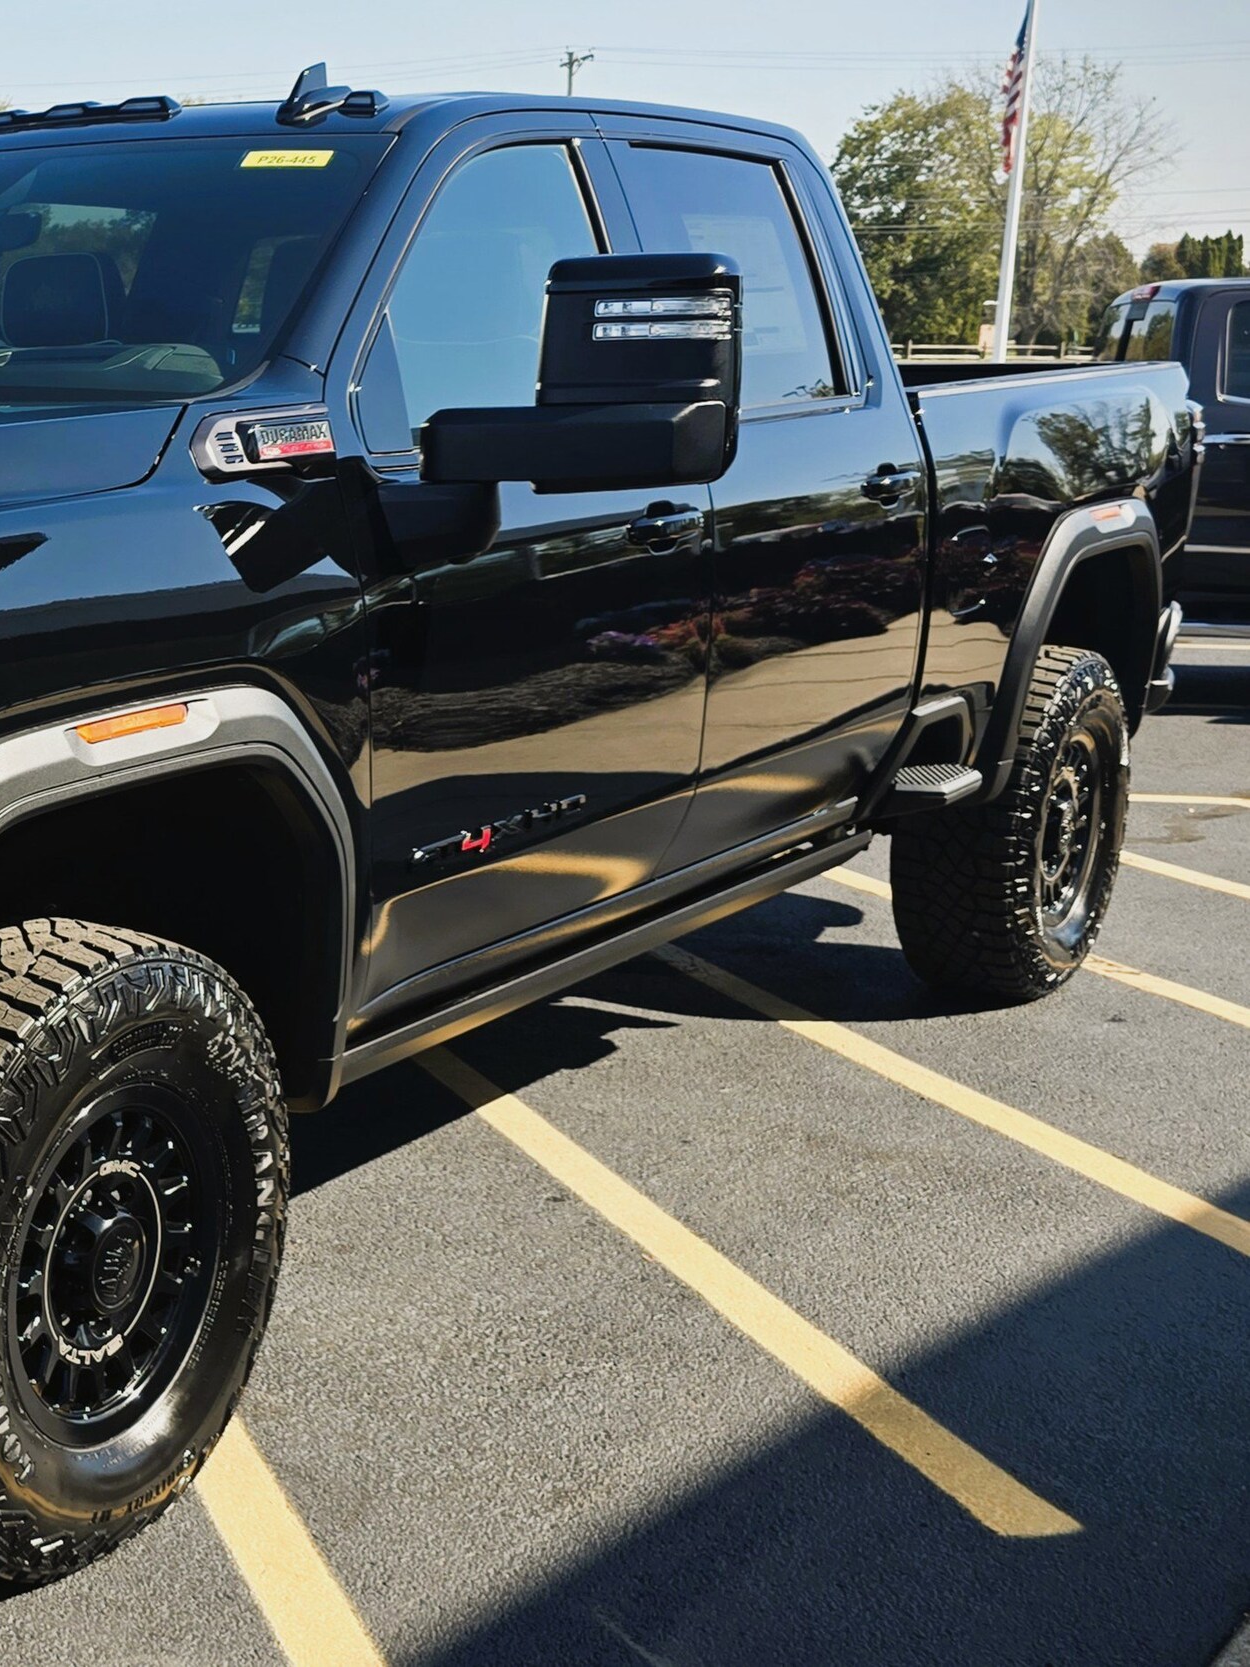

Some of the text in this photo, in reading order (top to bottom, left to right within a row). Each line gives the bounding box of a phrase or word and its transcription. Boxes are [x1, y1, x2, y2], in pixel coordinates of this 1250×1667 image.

[257, 155, 318, 165] P26-445
[259, 422, 328, 445] DURAMAX
[99, 1159, 142, 1178] GMC
